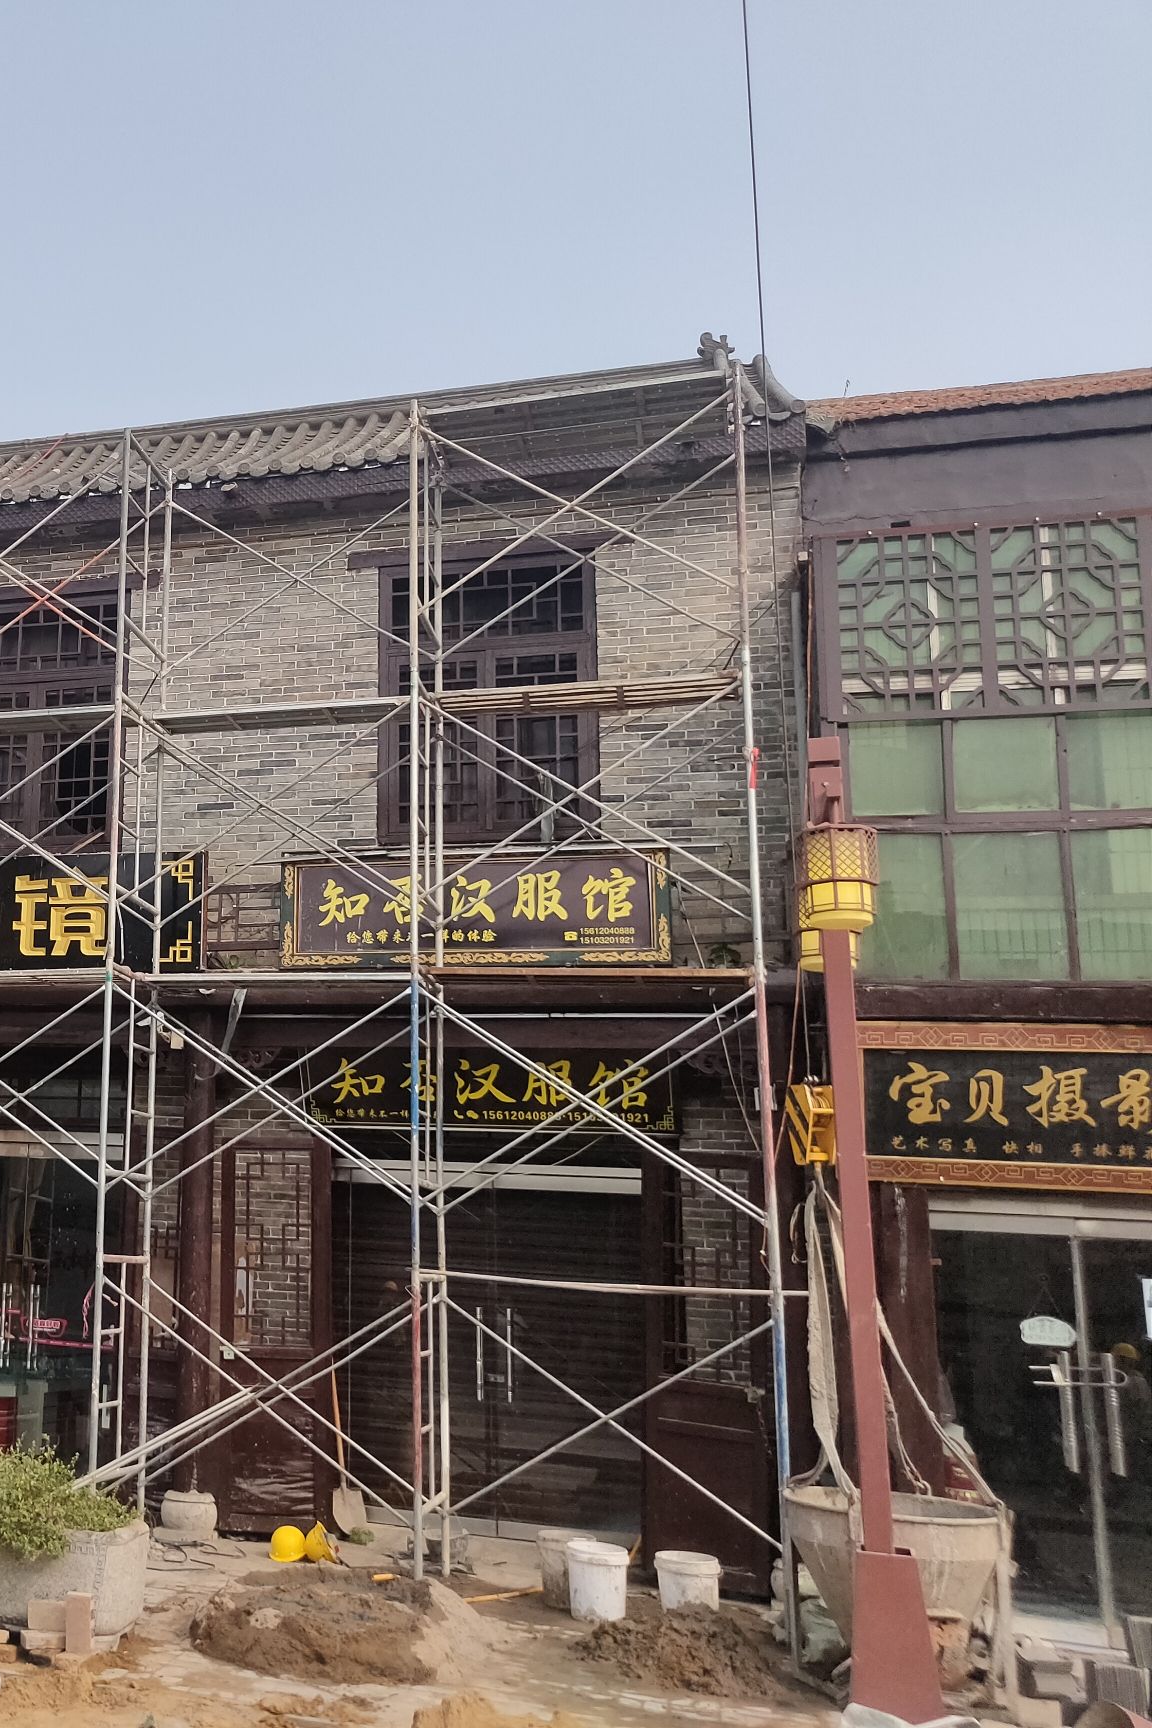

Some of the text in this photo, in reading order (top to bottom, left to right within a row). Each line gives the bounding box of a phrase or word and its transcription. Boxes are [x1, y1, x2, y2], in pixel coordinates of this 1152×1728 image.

[579, 926, 635, 935] 15612040888
[579, 936, 635, 944] 15103201921
[889, 1062, 1152, 1131] 宝贝摄影
[891, 1135, 977, 1153] 艺术写真
